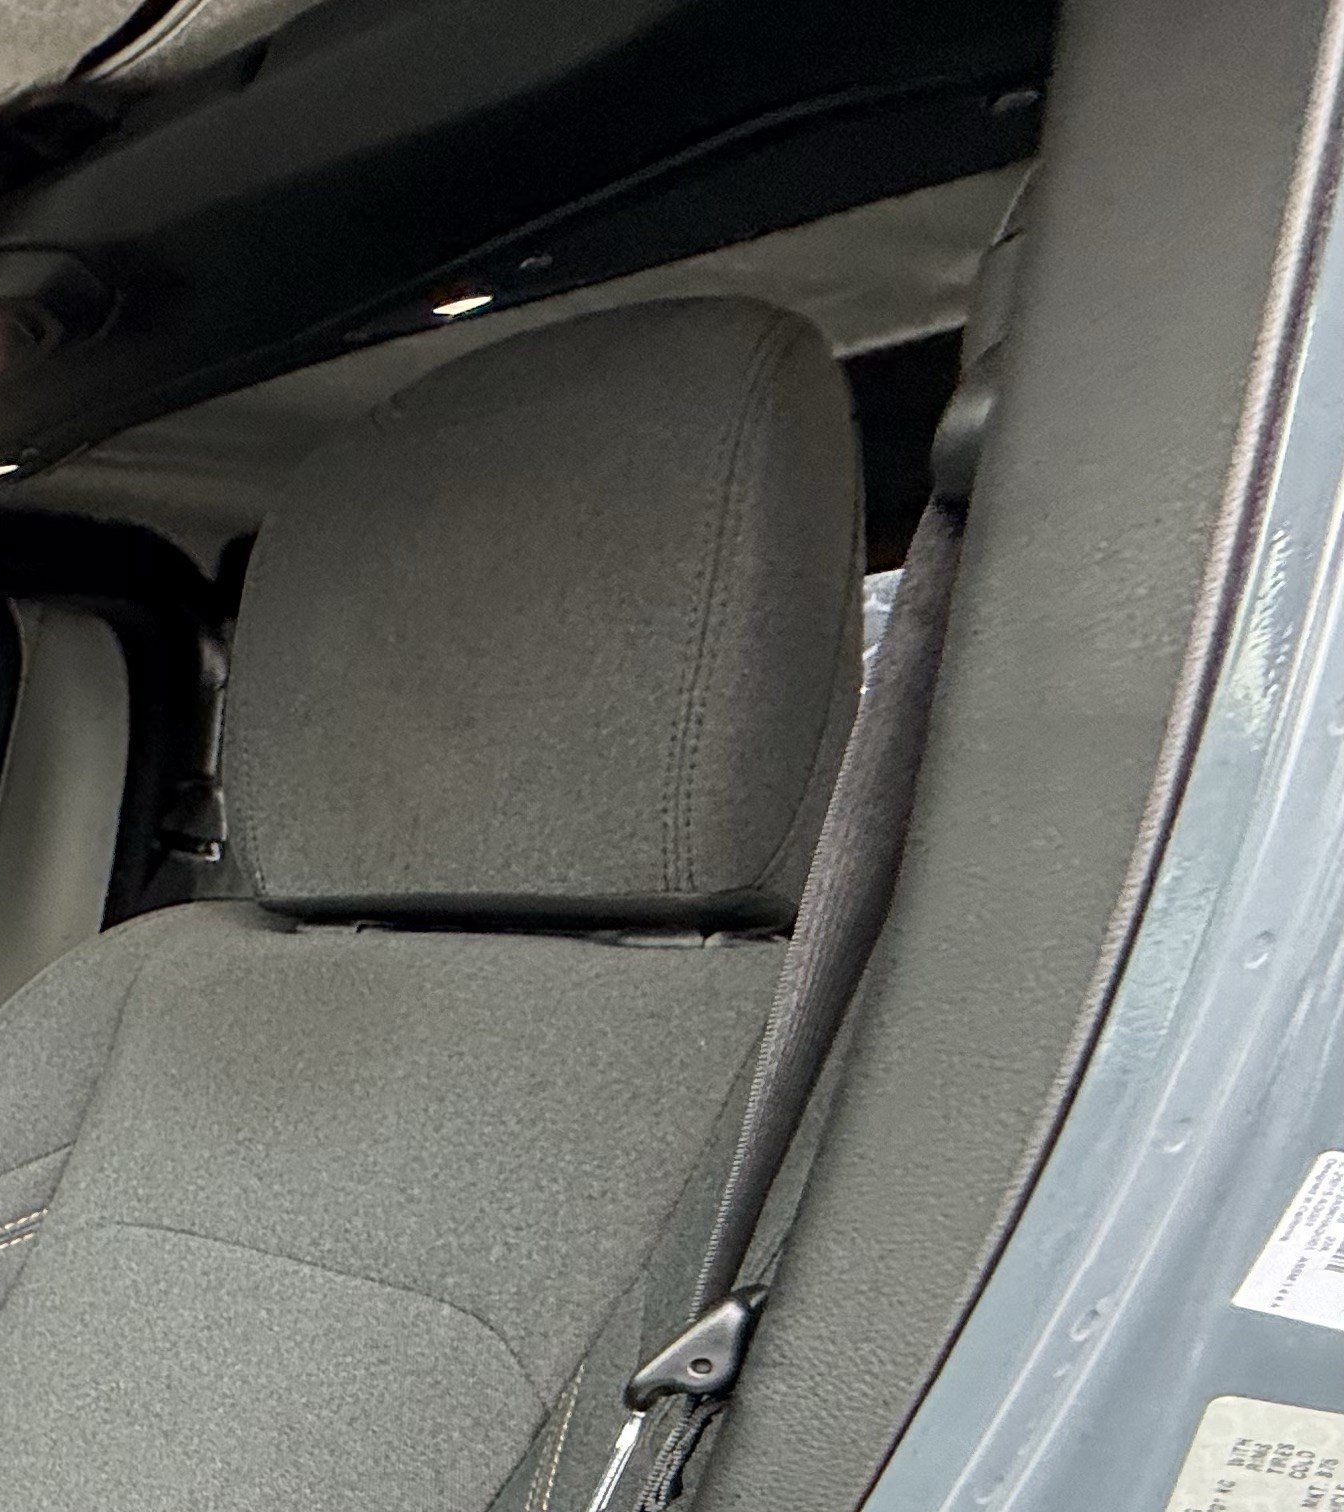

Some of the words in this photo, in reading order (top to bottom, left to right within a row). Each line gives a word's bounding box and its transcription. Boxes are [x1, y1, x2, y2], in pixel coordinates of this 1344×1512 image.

[1224, 1436, 1254, 1468] WITH
[1243, 1441, 1273, 1472] RIMS
[1265, 1442, 1296, 1475] TIRES
[1285, 1448, 1318, 1480] COLD
